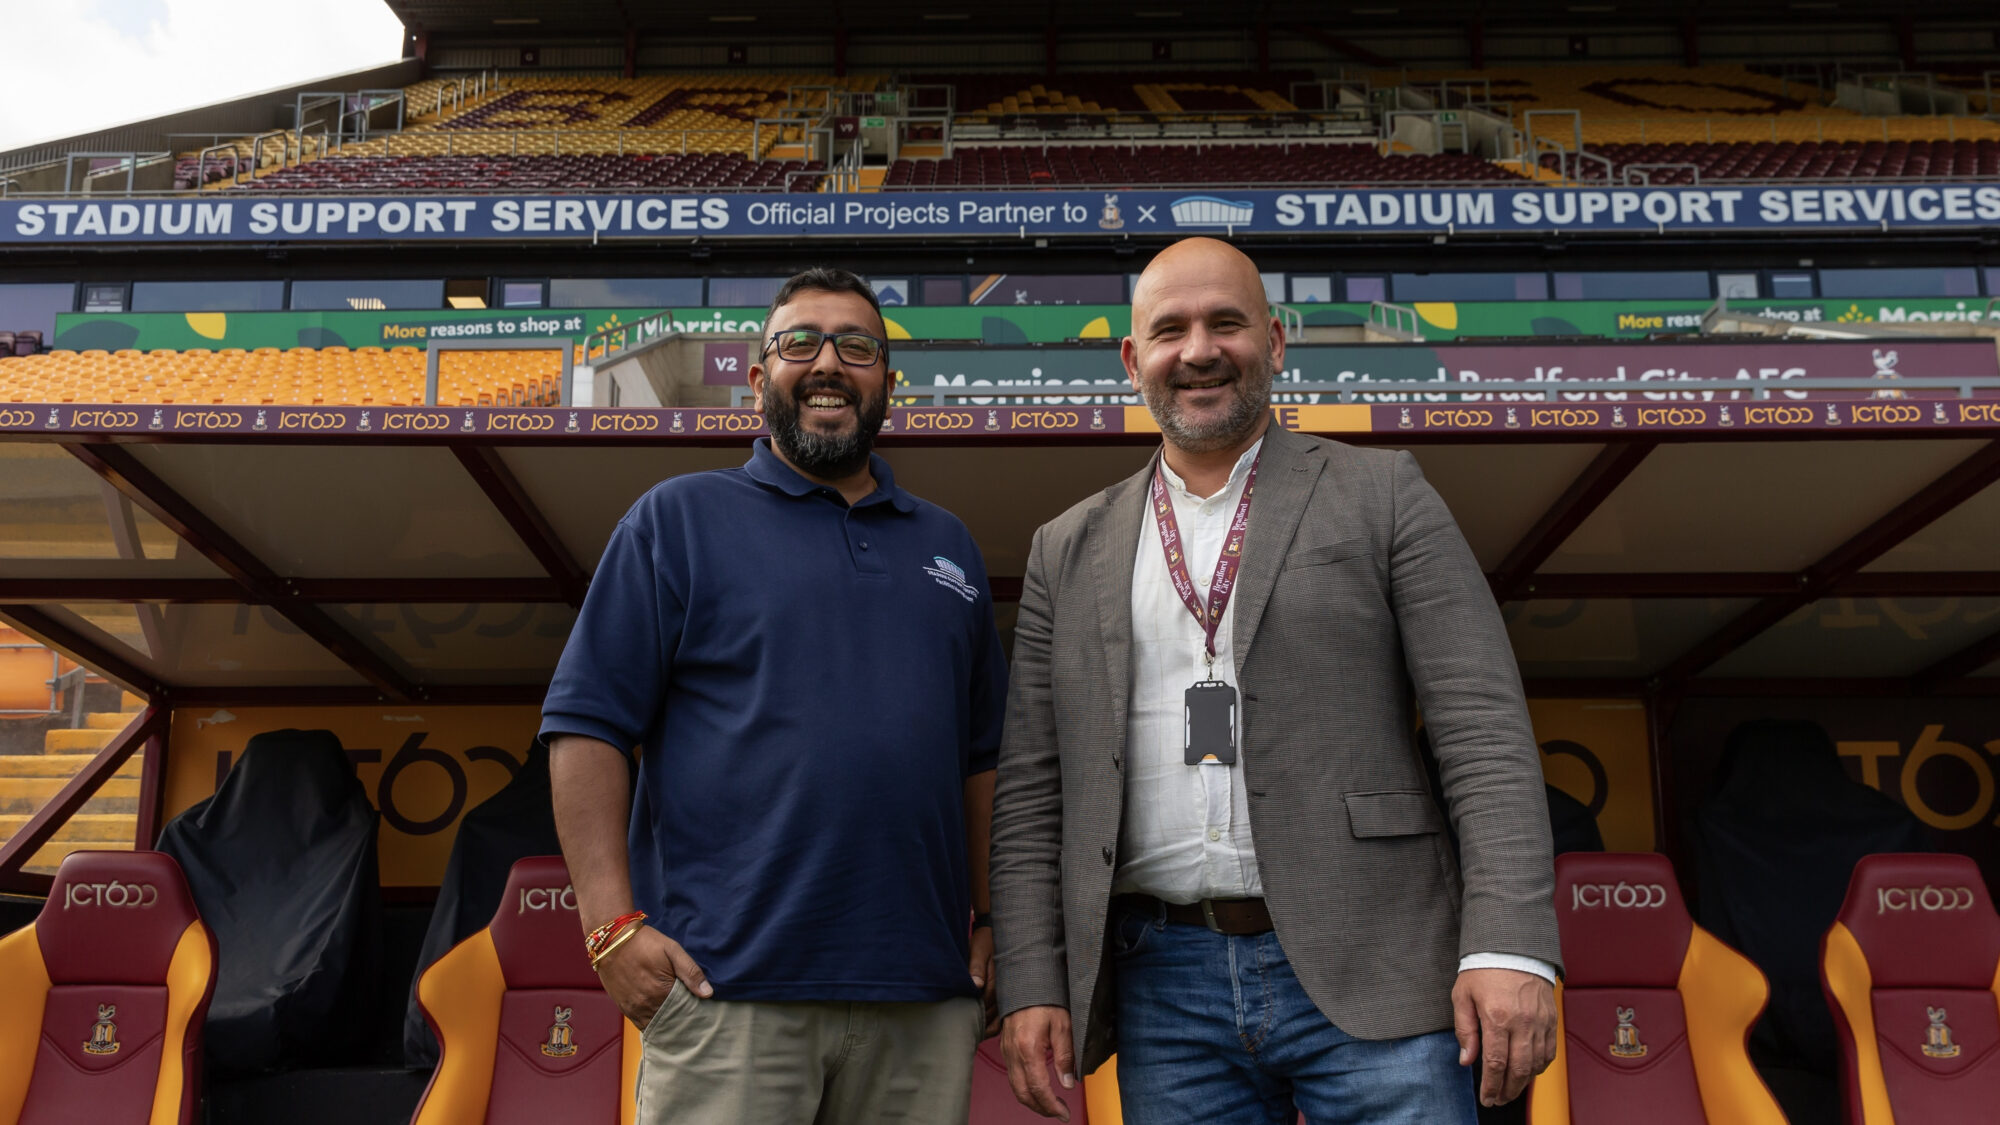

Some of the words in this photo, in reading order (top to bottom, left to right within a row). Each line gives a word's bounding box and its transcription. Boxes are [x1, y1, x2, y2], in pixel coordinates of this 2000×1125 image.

[16, 203, 233, 236] STADIUM
[249, 202, 476, 235] SUPPORT
[491, 198, 730, 232] SERVICES
[747, 202, 835, 225] Official
[845, 202, 950, 229] Projects
[959, 201, 1055, 224] Partner
[1063, 203, 1088, 222] to
[1275, 193, 1495, 226] STADIUM
[1511, 191, 1742, 223] SUPPORT
[1759, 187, 2000, 222] SERVICES
[383, 324, 426, 339] More
[430, 321, 493, 337] reasons
[497, 320, 516, 335] to
[519, 317, 559, 335] shop
[563, 317, 581, 331] at
[1619, 314, 1664, 330] More
[714, 357, 738, 371] V2
[71, 410, 138, 428] JCT600
[174, 411, 242, 429] JCT600
[278, 412, 346, 430] JCT600
[382, 412, 450, 430] JCT600
[486, 413, 554, 431] JCT600
[590, 413, 658, 431] JCT600
[696, 413, 763, 432] JCT600
[905, 412, 973, 430] JCT600
[1010, 411, 1079, 429] JCT600
[1424, 408, 1493, 427] JCT600
[1530, 408, 1599, 427] JCT600
[1637, 407, 1706, 427] JCT600
[1744, 406, 1814, 425] JCT600
[1851, 405, 1921, 424] JCT600
[1212, 560, 1229, 592] Bradford
[1220, 578, 1232, 594] City
[64, 880, 158, 910] JCT600
[1571, 881, 1667, 911] JCT600
[1876, 884, 1975, 915] JCT600
